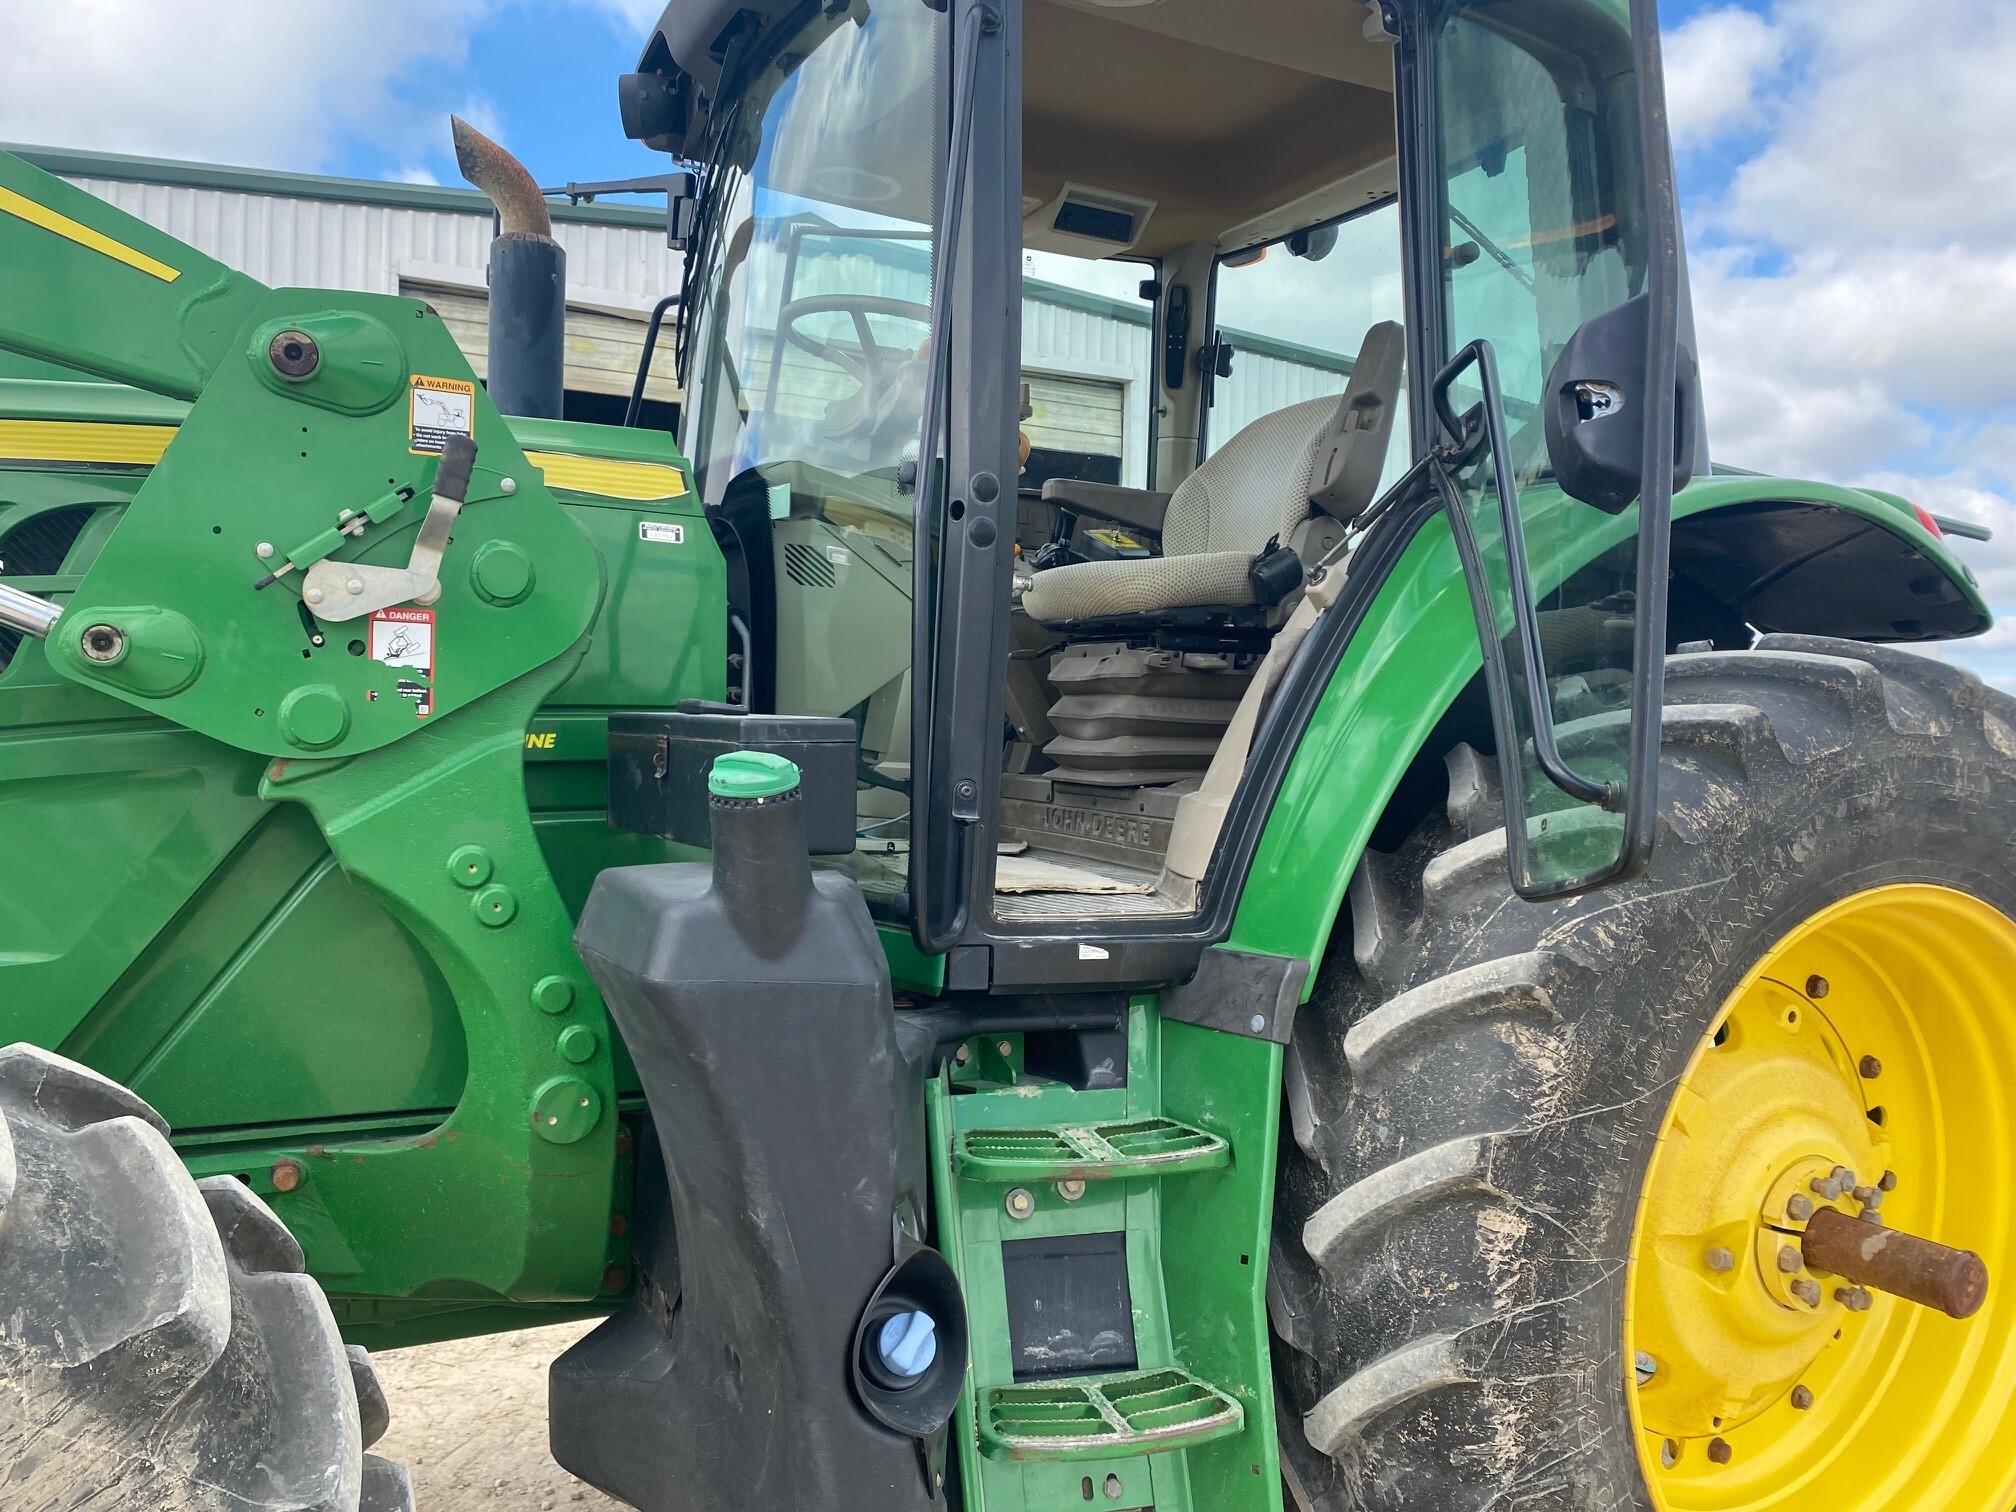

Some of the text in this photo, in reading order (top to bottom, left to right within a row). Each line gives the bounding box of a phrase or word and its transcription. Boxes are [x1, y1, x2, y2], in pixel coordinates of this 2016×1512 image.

[426, 380, 471, 392] WARNING
[389, 611, 430, 621] DANGER
[1043, 807, 1152, 846] JOHN DEERE
